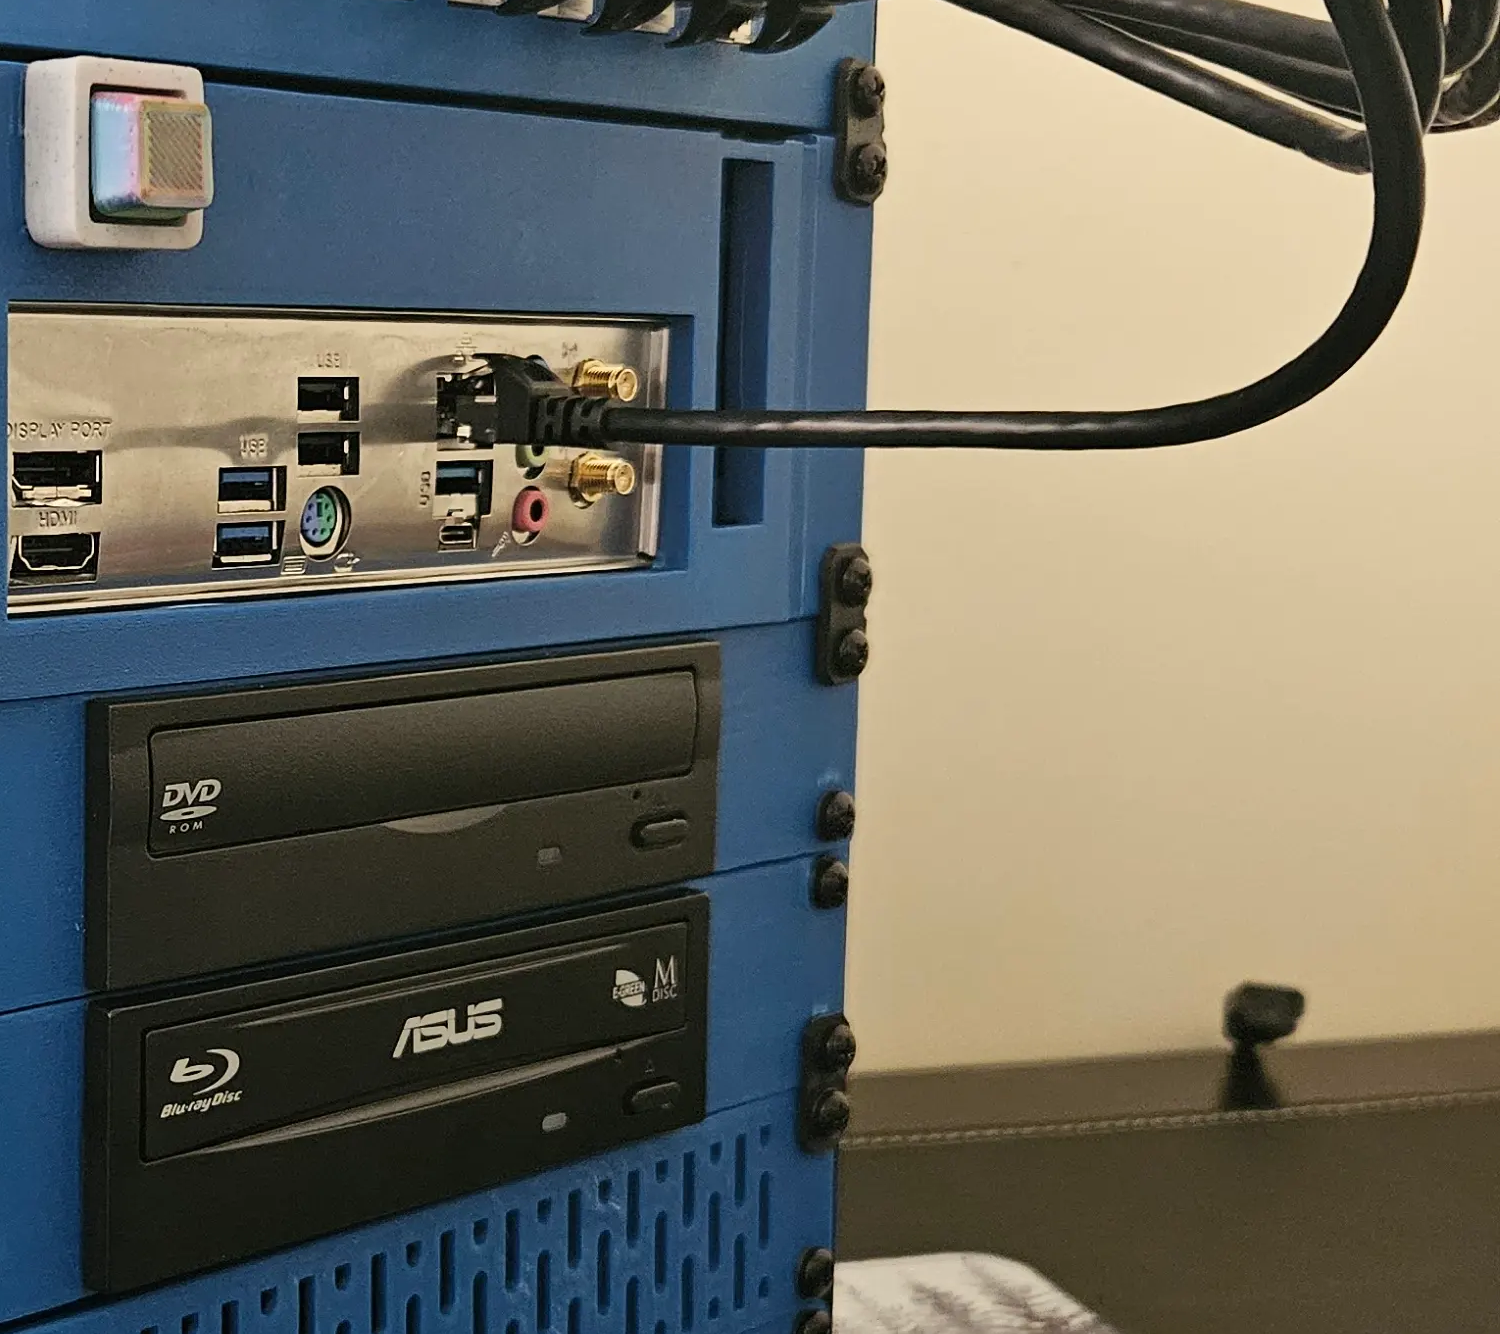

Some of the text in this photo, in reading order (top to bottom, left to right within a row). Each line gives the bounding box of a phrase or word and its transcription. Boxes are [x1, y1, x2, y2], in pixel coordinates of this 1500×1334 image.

[71, 421, 112, 439] PORT
[38, 510, 78, 528] HDMI
[162, 778, 222, 808] DVD
[168, 820, 203, 835] ROM
[654, 954, 676, 989] M
[652, 984, 678, 1003] DISC
[392, 997, 503, 1059] ASUS
